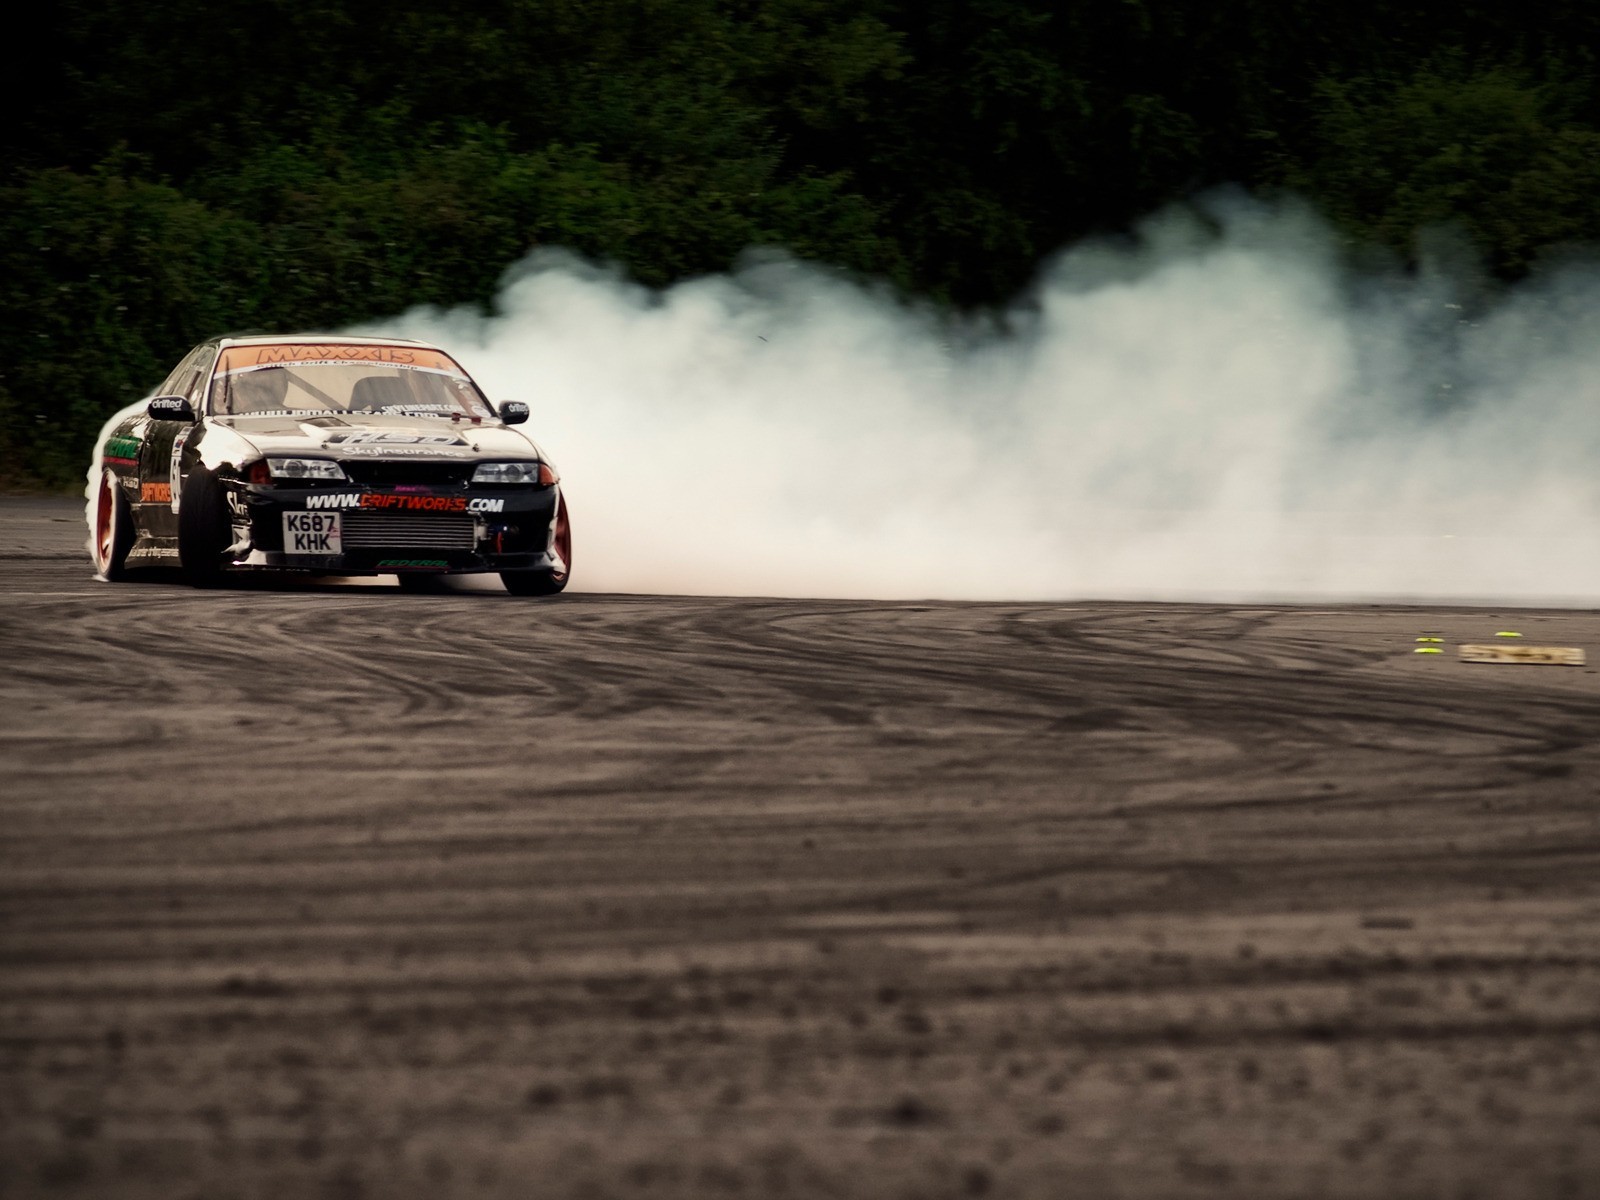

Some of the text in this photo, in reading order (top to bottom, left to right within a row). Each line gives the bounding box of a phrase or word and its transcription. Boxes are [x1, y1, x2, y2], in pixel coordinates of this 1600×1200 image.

[256, 346, 415, 364] MAXXIS
[152, 400, 183, 409] drifted
[306, 494, 504, 512] WWW.DRIFTWORKS.COM
[287, 515, 335, 532] K687
[295, 533, 332, 550] KHK
[376, 559, 449, 567] FEDERAL
